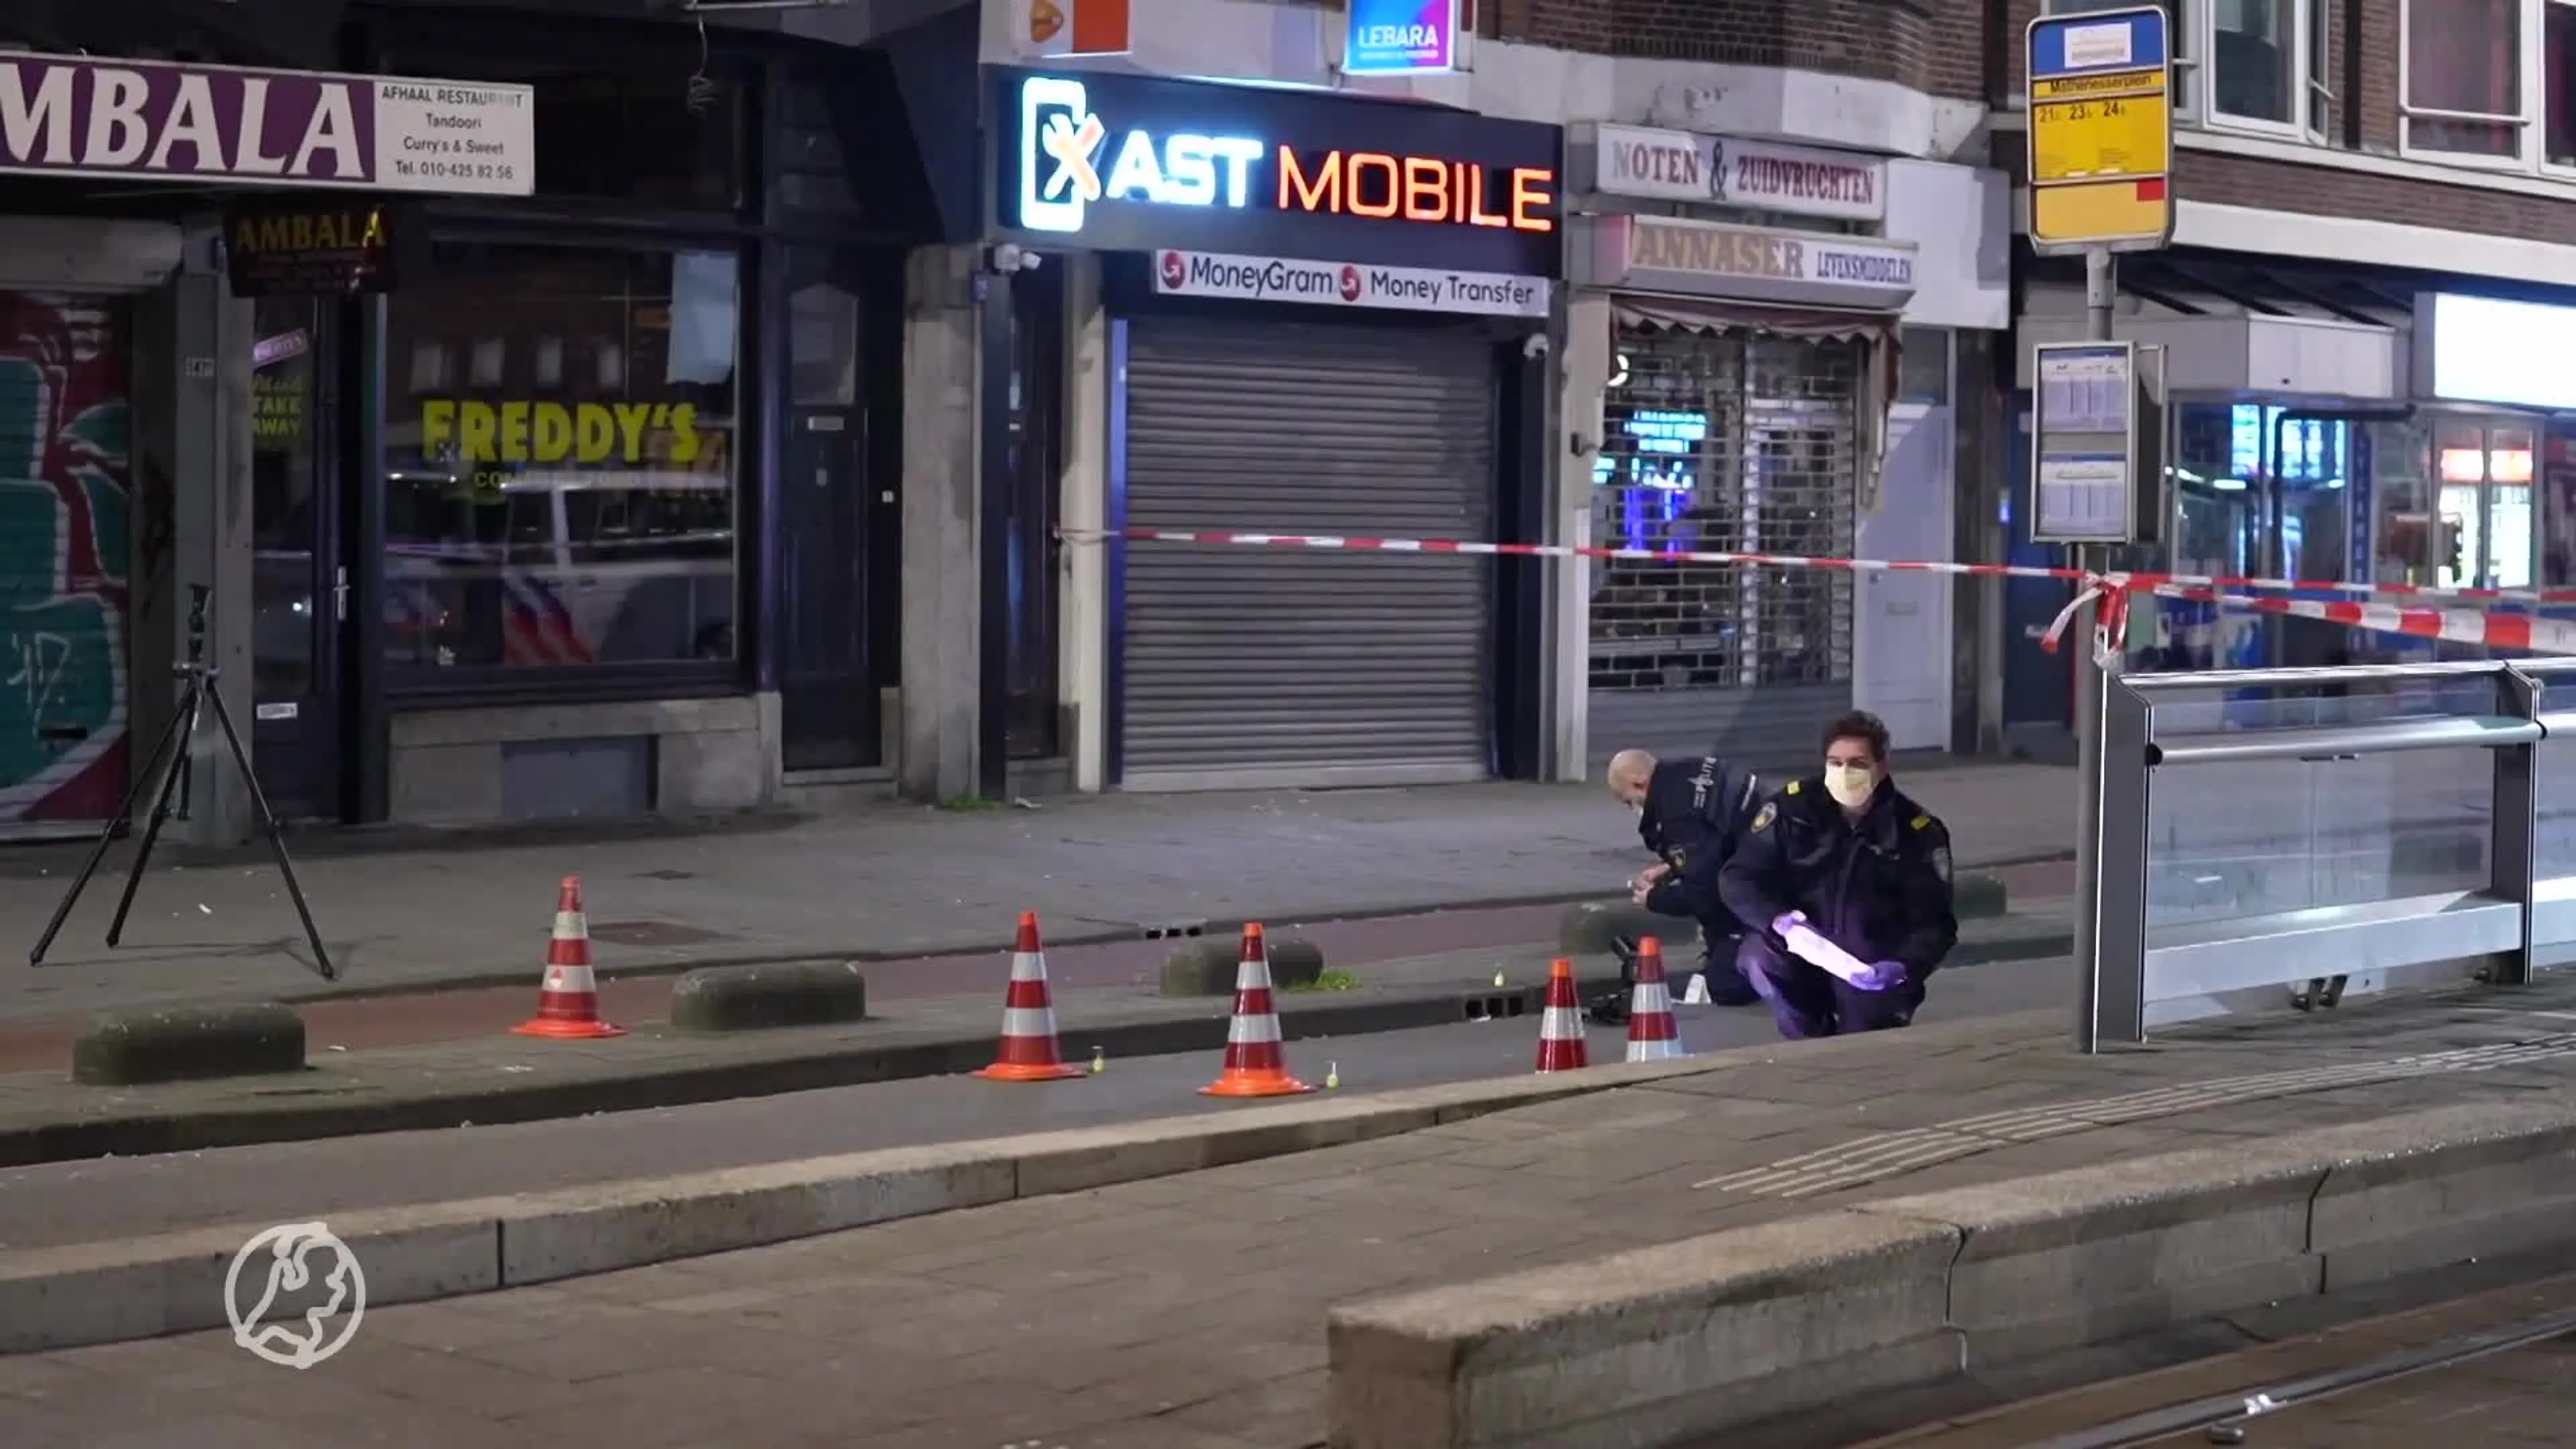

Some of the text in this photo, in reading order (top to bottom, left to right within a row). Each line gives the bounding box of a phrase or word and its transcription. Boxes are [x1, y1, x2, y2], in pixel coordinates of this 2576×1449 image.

[1358, 26, 1439, 48] LEBARA
[382, 87, 432, 102] AFHAAL
[2103, 101, 2120, 117] 24
[426, 113, 482, 129] Tandoori
[2070, 104, 2086, 121] 23
[453, 140, 463, 152] &
[466, 140, 504, 156] Sweet
[1612, 139, 1701, 184] NOTEN
[1709, 140, 1728, 201] &
[1279, 146, 1553, 231] MOBILE
[236, 207, 386, 250] AMBALA
[1633, 225, 1805, 278] ANNASER
[1190, 256, 1535, 305] MoneyGram Money Transfer
[422, 400, 700, 463] FREDDY'S
